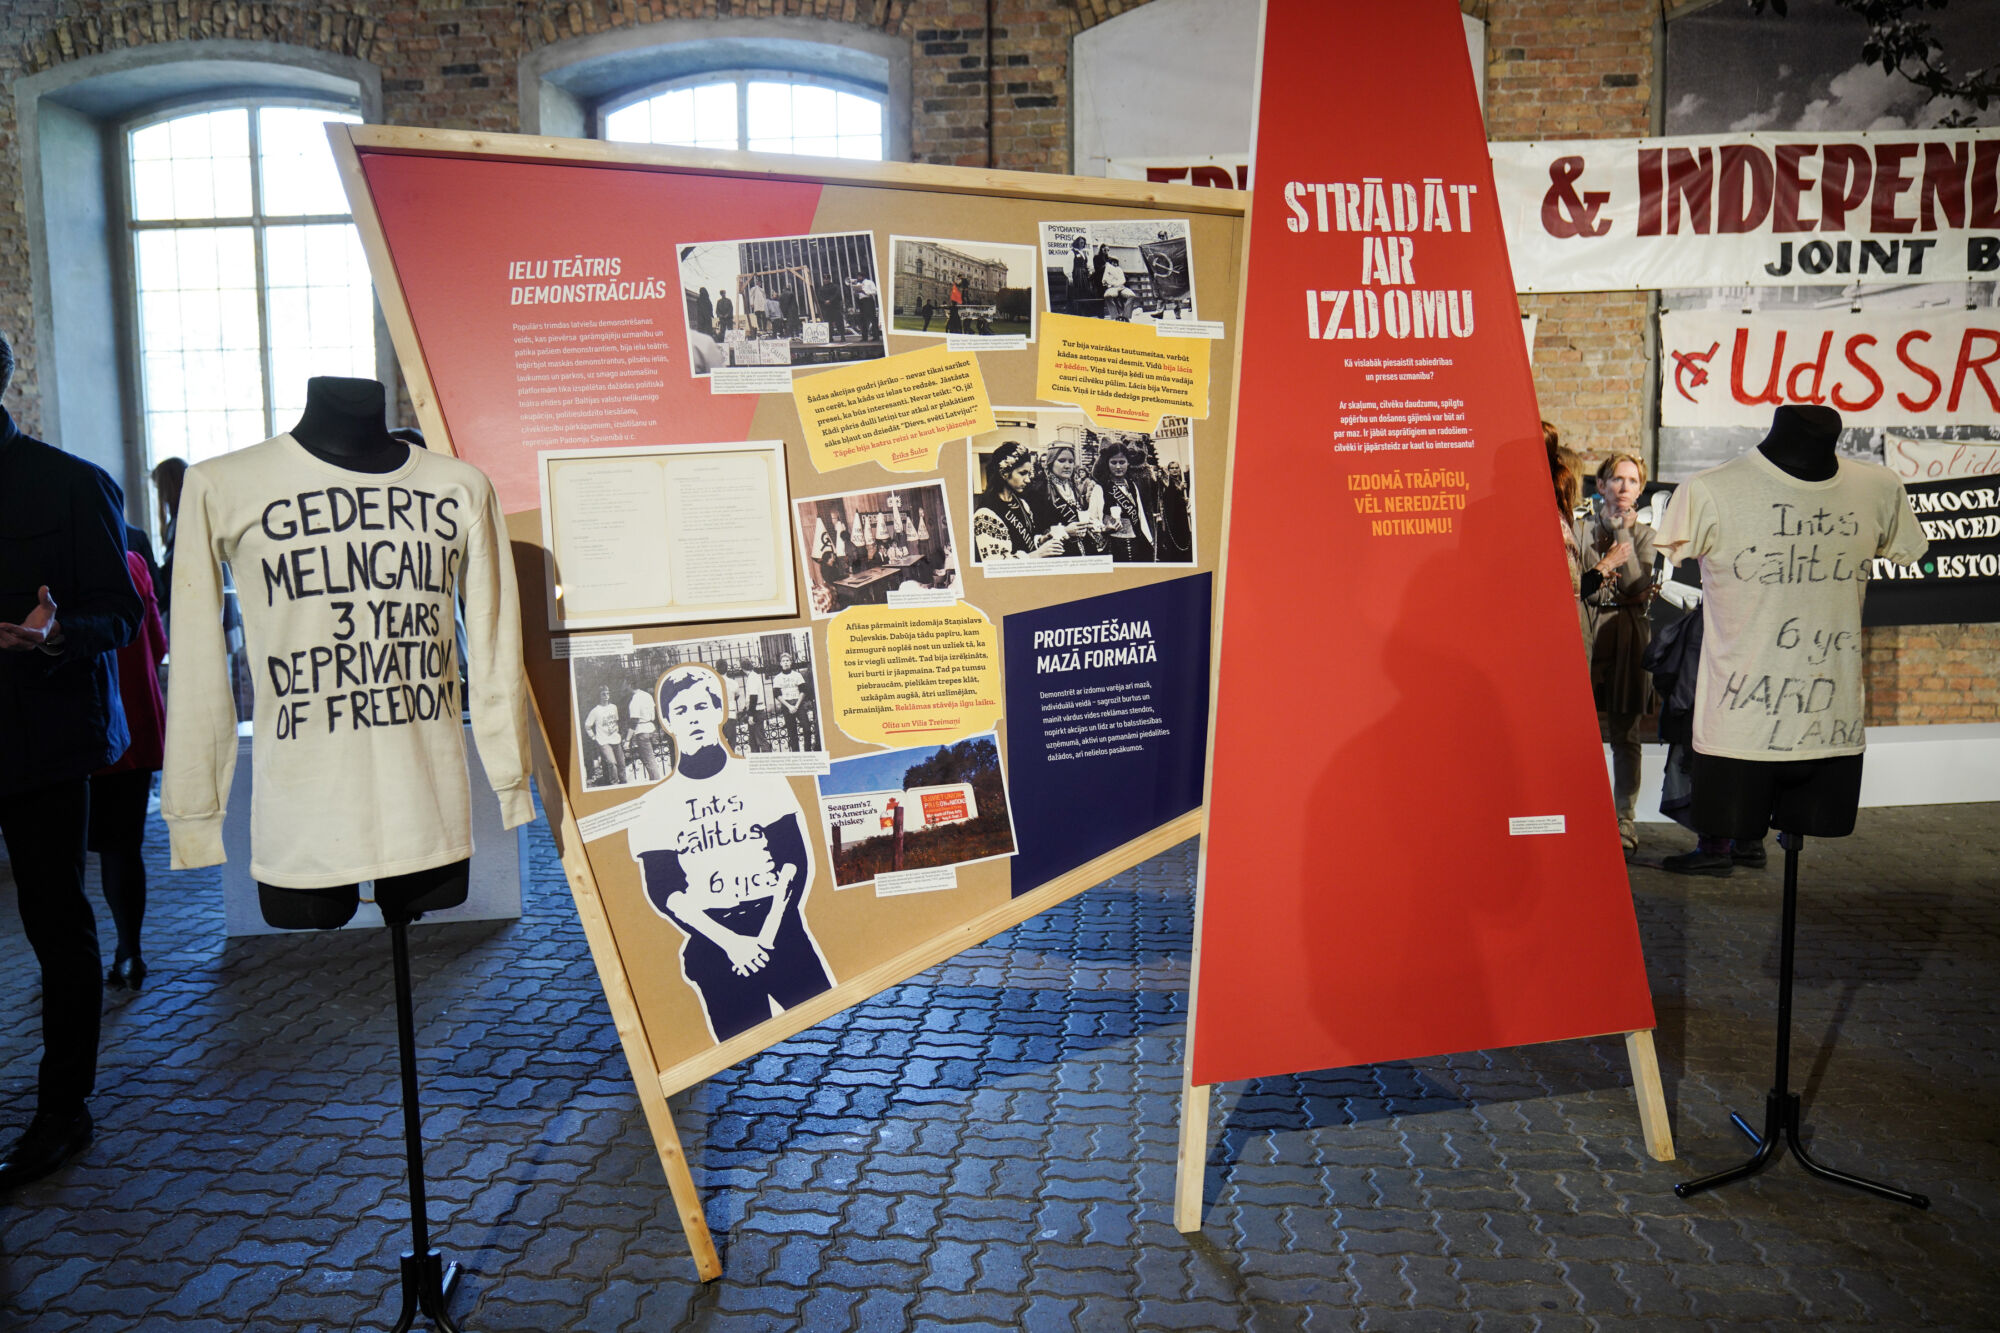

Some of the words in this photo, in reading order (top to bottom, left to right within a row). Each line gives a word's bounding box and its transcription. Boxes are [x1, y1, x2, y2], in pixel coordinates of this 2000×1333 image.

[1284, 178, 1477, 232] STRĀDĀT
[1542, 156, 1613, 239] &
[509, 260, 548, 280] IELU
[552, 255, 621, 278] TEĀTRIS
[1362, 236, 1416, 285] AR
[1765, 240, 1936, 276] JOINT
[511, 277, 666, 305] DEMONSTRĀCIJĀS
[1306, 290, 1474, 339] IZDOMU
[1730, 328, 2000, 413] UdSSR
[1348, 470, 1403, 490] IZDOMĀ
[1405, 468, 1470, 490] TRĀPĪGU,
[262, 487, 458, 540] GEDERTS
[1354, 494, 1382, 513] VĒL
[1385, 491, 1466, 512] NEREDZĒTU
[1772, 503, 1858, 536] Ints
[1372, 518, 1452, 536] NOTIKUMU!
[262, 541, 459, 607] MELNGAILIS
[1937, 554, 2000, 578] ESTO
[331, 602, 354, 640] 3
[367, 601, 439, 639] YEARS
[1034, 618, 1152, 649] PROTESTĒŠANA
[1777, 617, 1800, 650] 6
[268, 639, 452, 697] DEPRIVATION
[1037, 648, 1081, 674] MAZĀ
[1084, 640, 1157, 669] FORMĀTĀ
[1717, 672, 1835, 715] HARD
[277, 701, 310, 739] OF
[686, 796, 743, 822] Ints
[710, 871, 724, 893] 6
